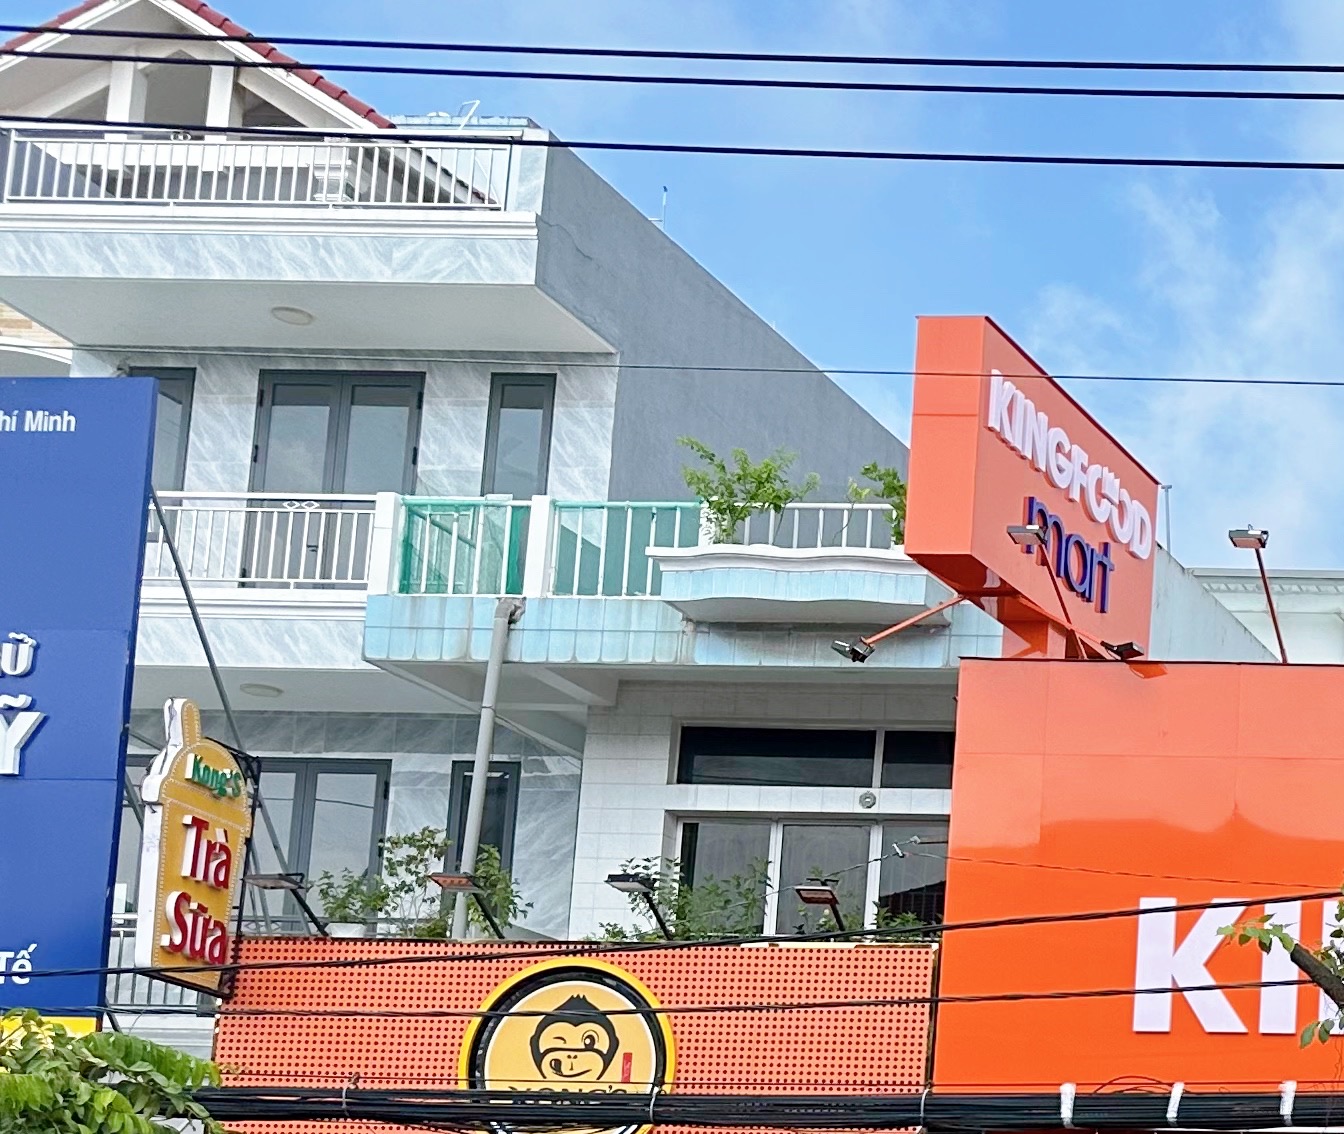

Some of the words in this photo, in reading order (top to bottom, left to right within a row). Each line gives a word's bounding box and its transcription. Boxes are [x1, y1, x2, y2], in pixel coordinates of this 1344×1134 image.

[0, 409, 19, 432] hí
[24, 410, 77, 432] Minh
[987, 369, 1153, 560] KINGFOOD
[1022, 495, 1116, 614] mart
[181, 815, 233, 890] Trà
[162, 891, 228, 965] Sữa
